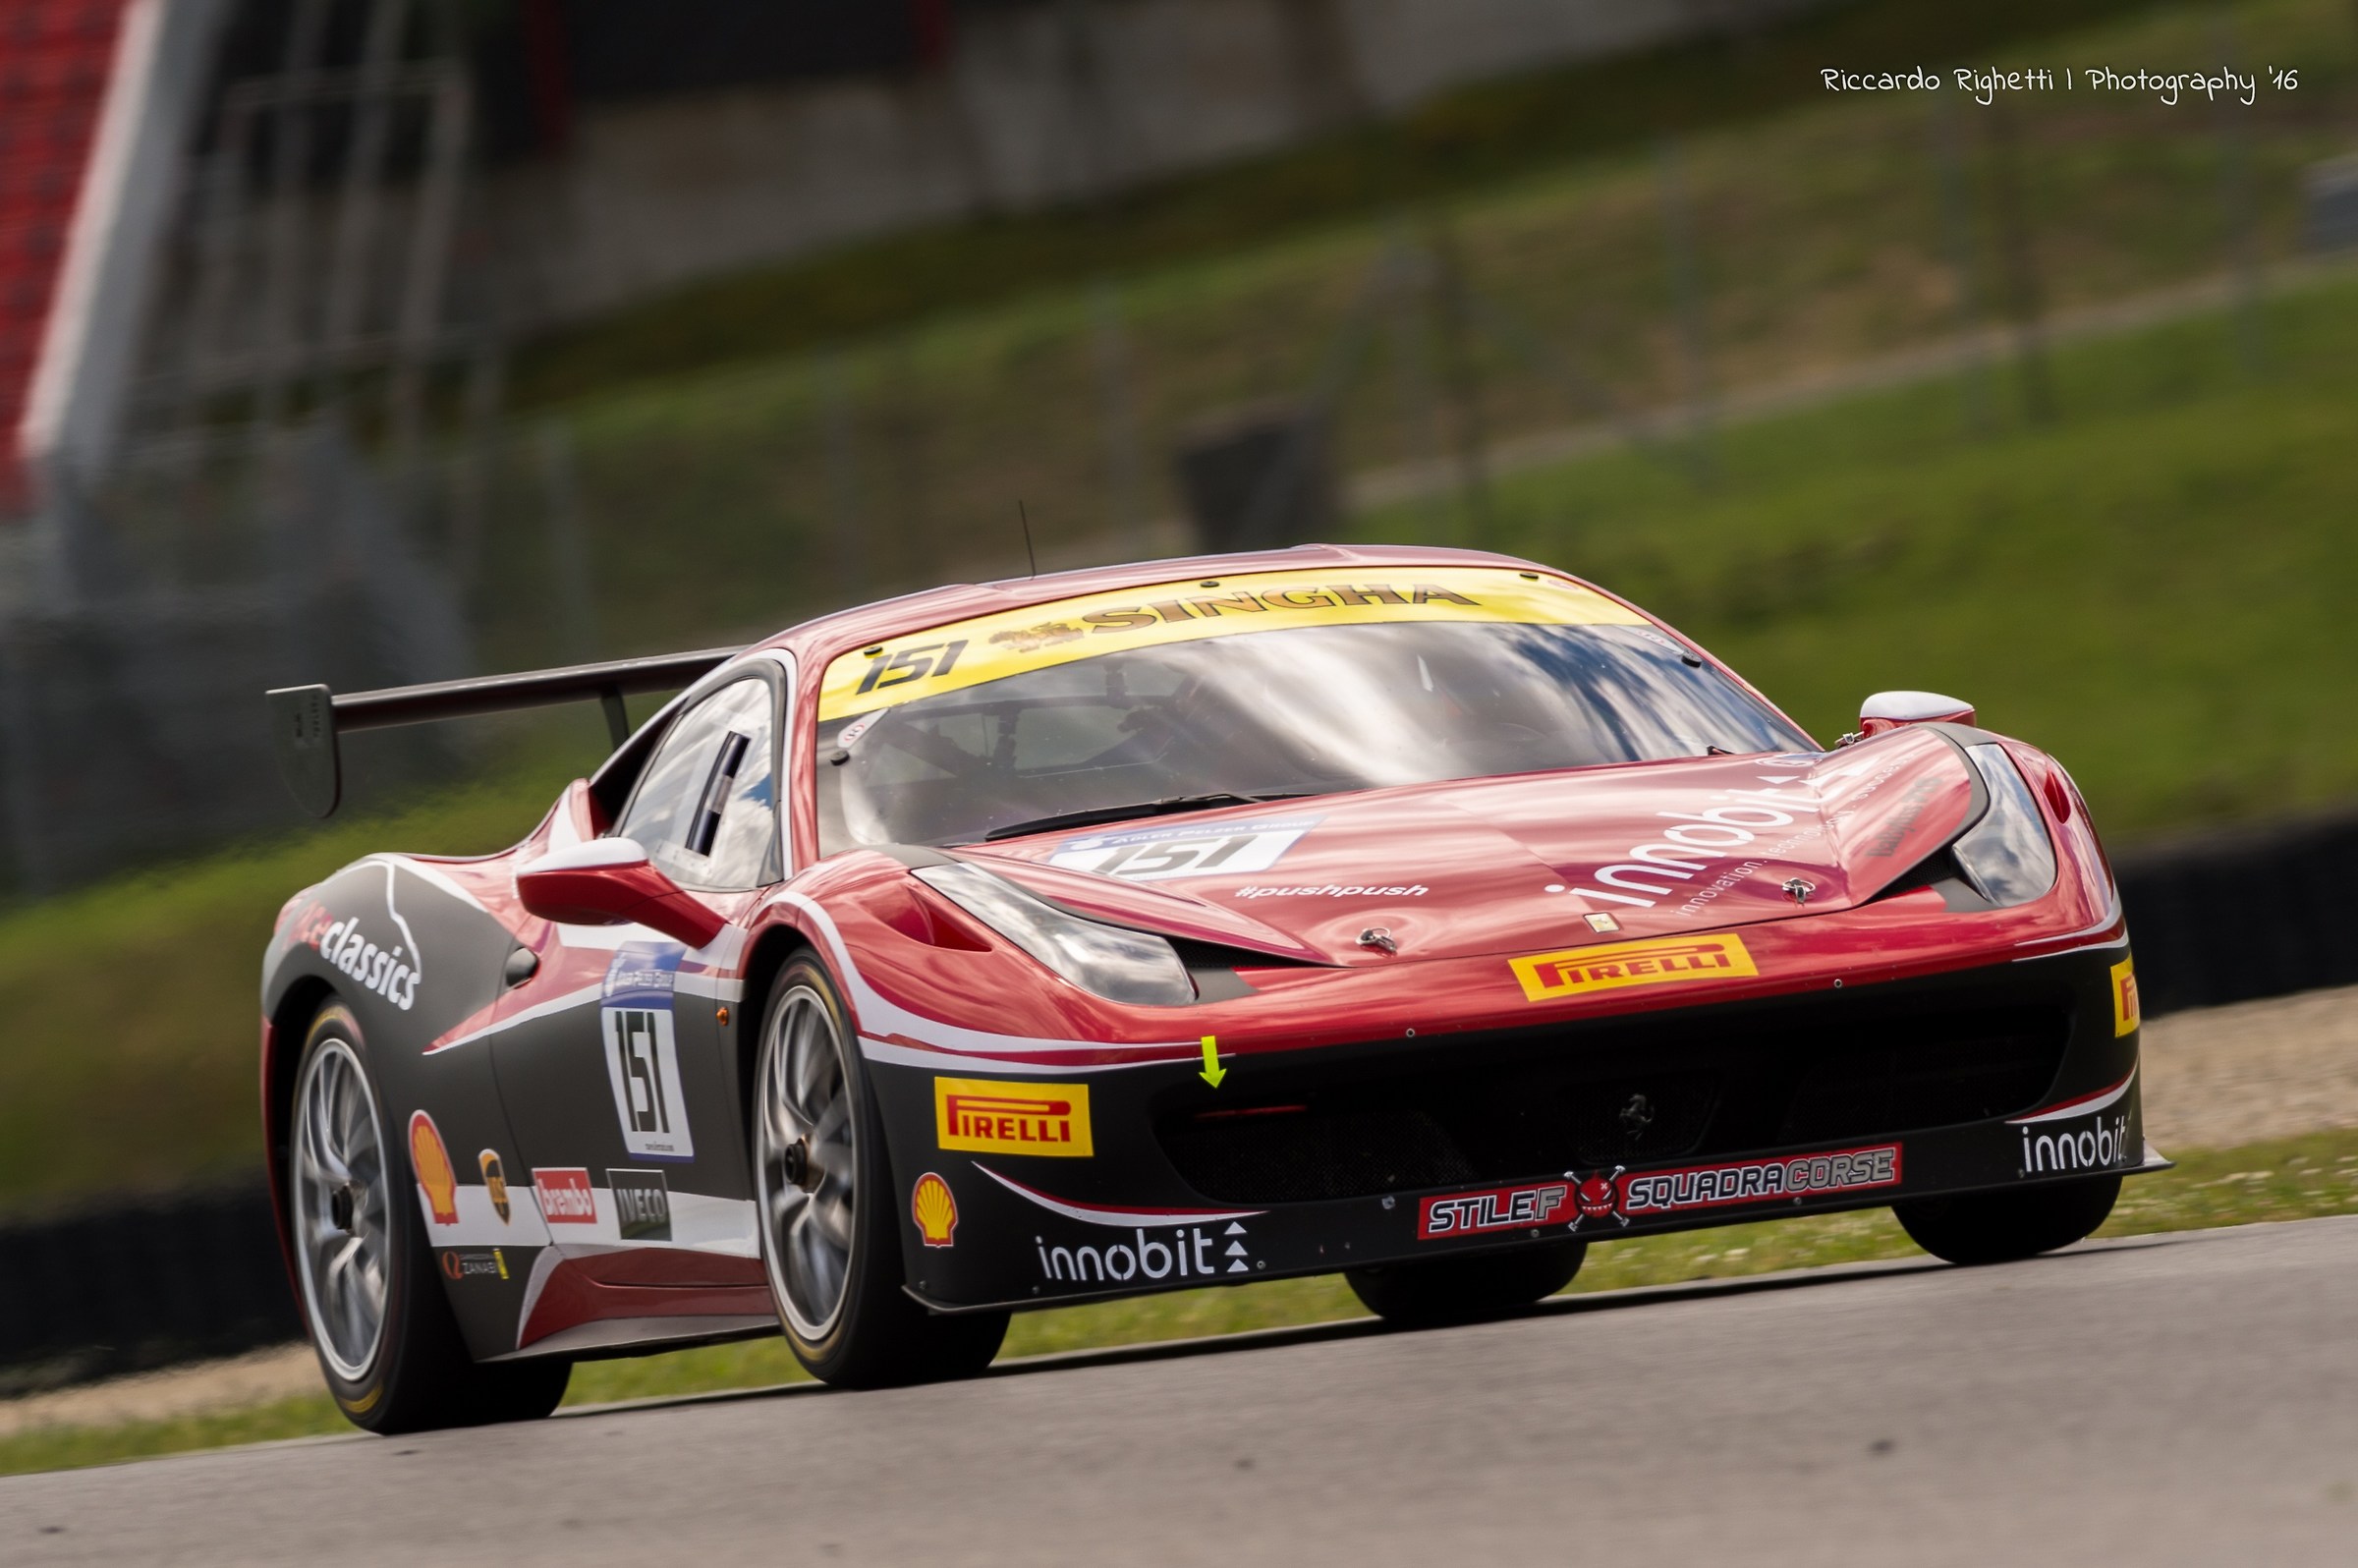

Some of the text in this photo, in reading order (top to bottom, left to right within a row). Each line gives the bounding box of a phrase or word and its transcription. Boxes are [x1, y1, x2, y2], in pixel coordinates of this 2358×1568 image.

[857, 583, 1484, 695] 151 SINGHA
[1092, 834, 1260, 876] 151
[1234, 882, 1430, 899] #pushpush
[1533, 942, 1732, 988] PIRELLI
[615, 1011, 670, 1134] 151
[947, 1094, 1072, 1143] PIRELLI
[2023, 1115, 2128, 1173] innobit
[537, 1177, 592, 1216] brembo
[615, 1187, 667, 1221] IVECO
[1035, 1227, 1215, 1282] innobit
